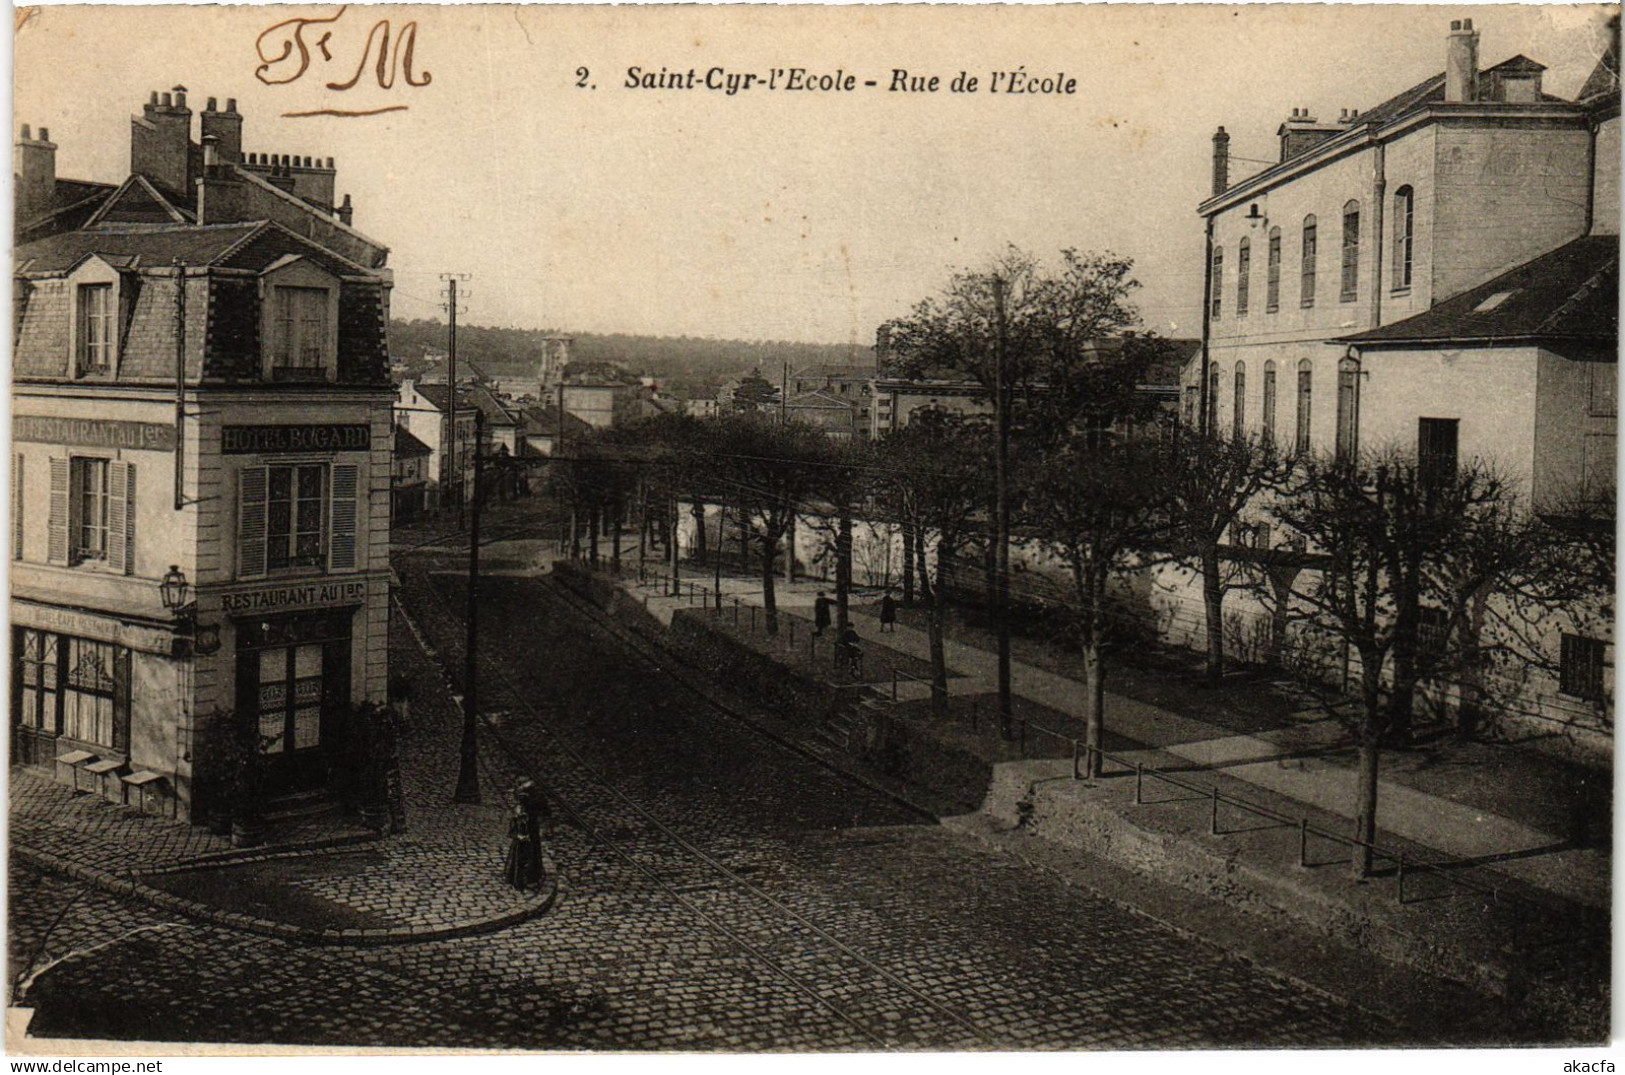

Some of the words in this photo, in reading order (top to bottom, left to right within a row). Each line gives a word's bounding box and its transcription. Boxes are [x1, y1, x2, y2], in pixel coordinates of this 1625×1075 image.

[575, 66, 597, 89] 2.
[624, 66, 856, 96] Saint-Cyr-l'Ecole
[888, 68, 940, 92] Rue
[950, 71, 978, 93] de
[990, 65, 1077, 95] l'École
[29, 419, 117, 445] RESTAURANT
[288, 427, 370, 449] BOGARD
[221, 587, 317, 611] RESTAURANT
